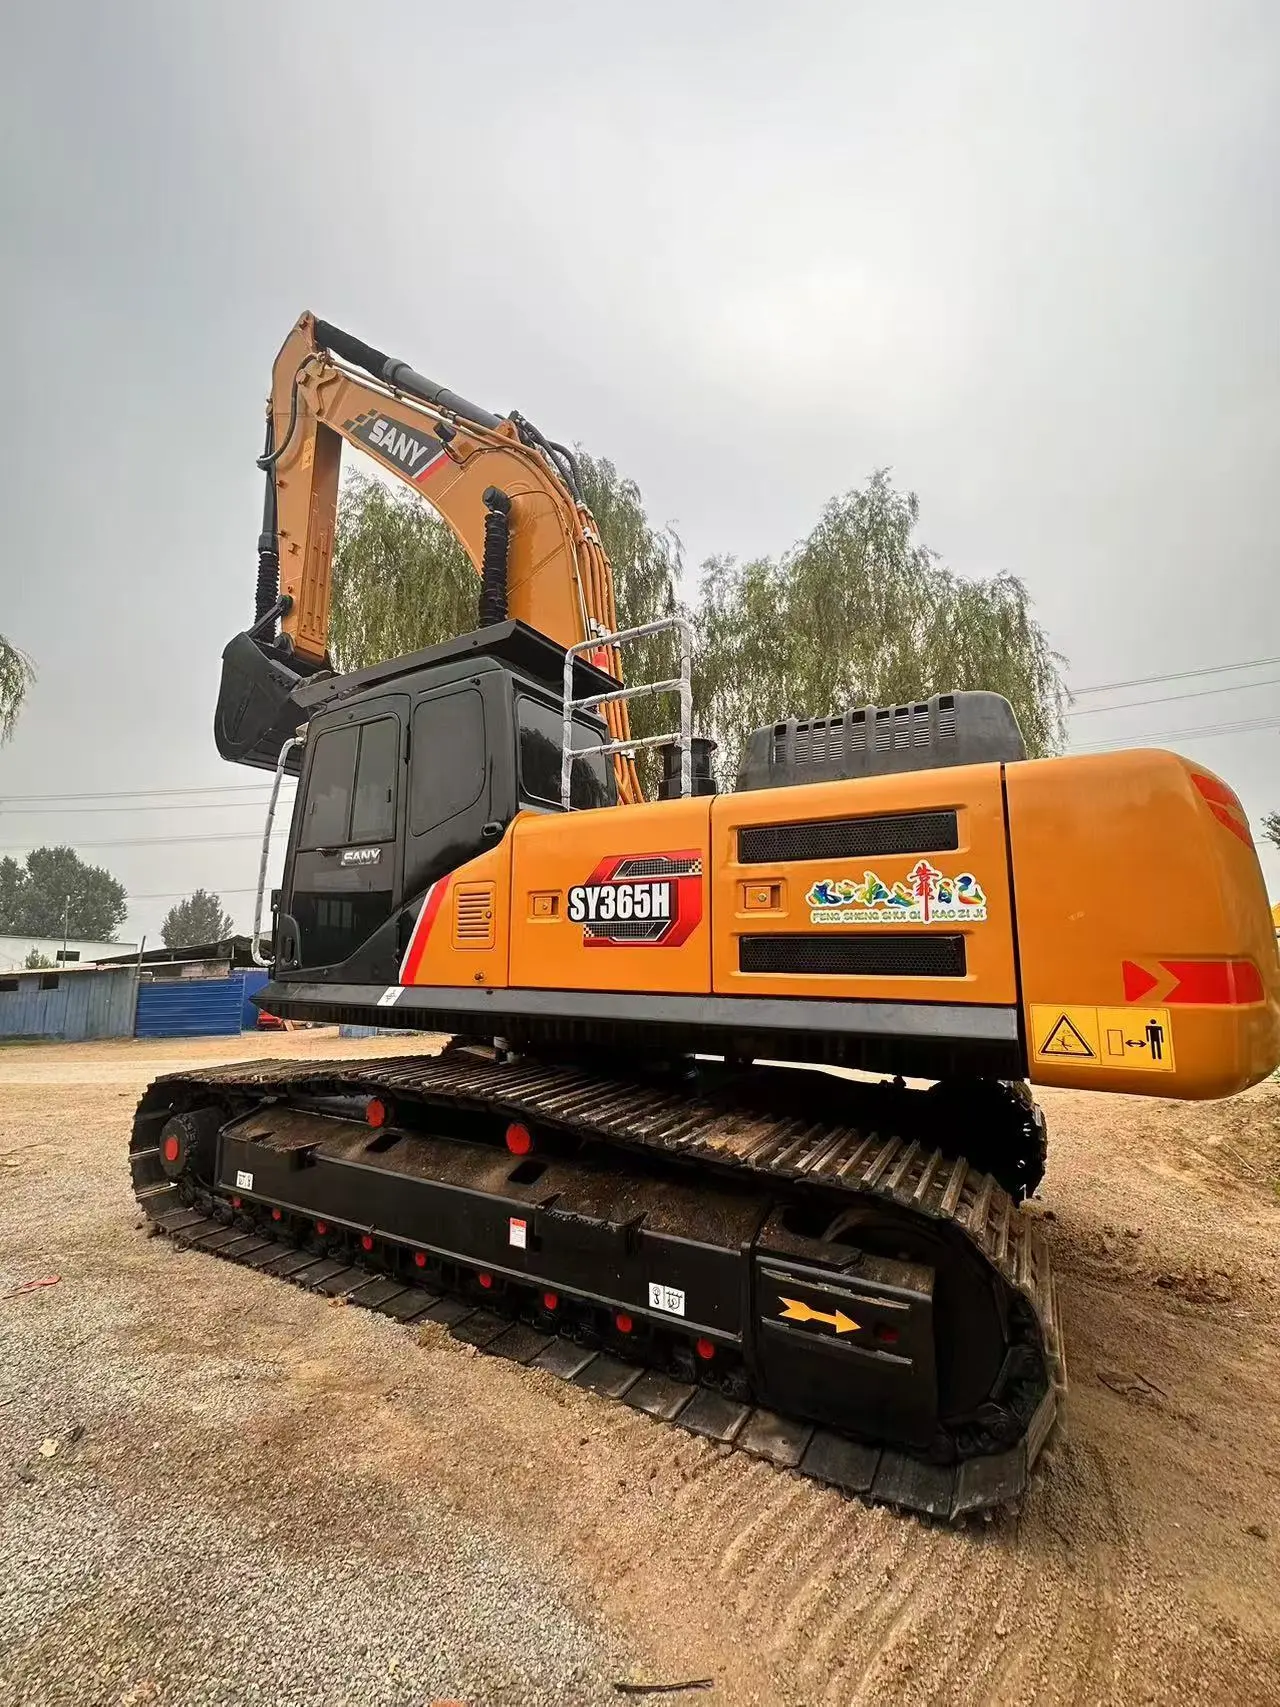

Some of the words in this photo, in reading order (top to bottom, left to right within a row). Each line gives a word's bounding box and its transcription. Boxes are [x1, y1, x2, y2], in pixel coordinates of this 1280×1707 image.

[368, 419, 428, 467] SANY
[341, 848, 381, 866] SANY
[570, 882, 670, 921] SY365H
[813, 911, 841, 921] FENG
[843, 911, 880, 921] SHENG
[931, 909, 956, 919] KAO
